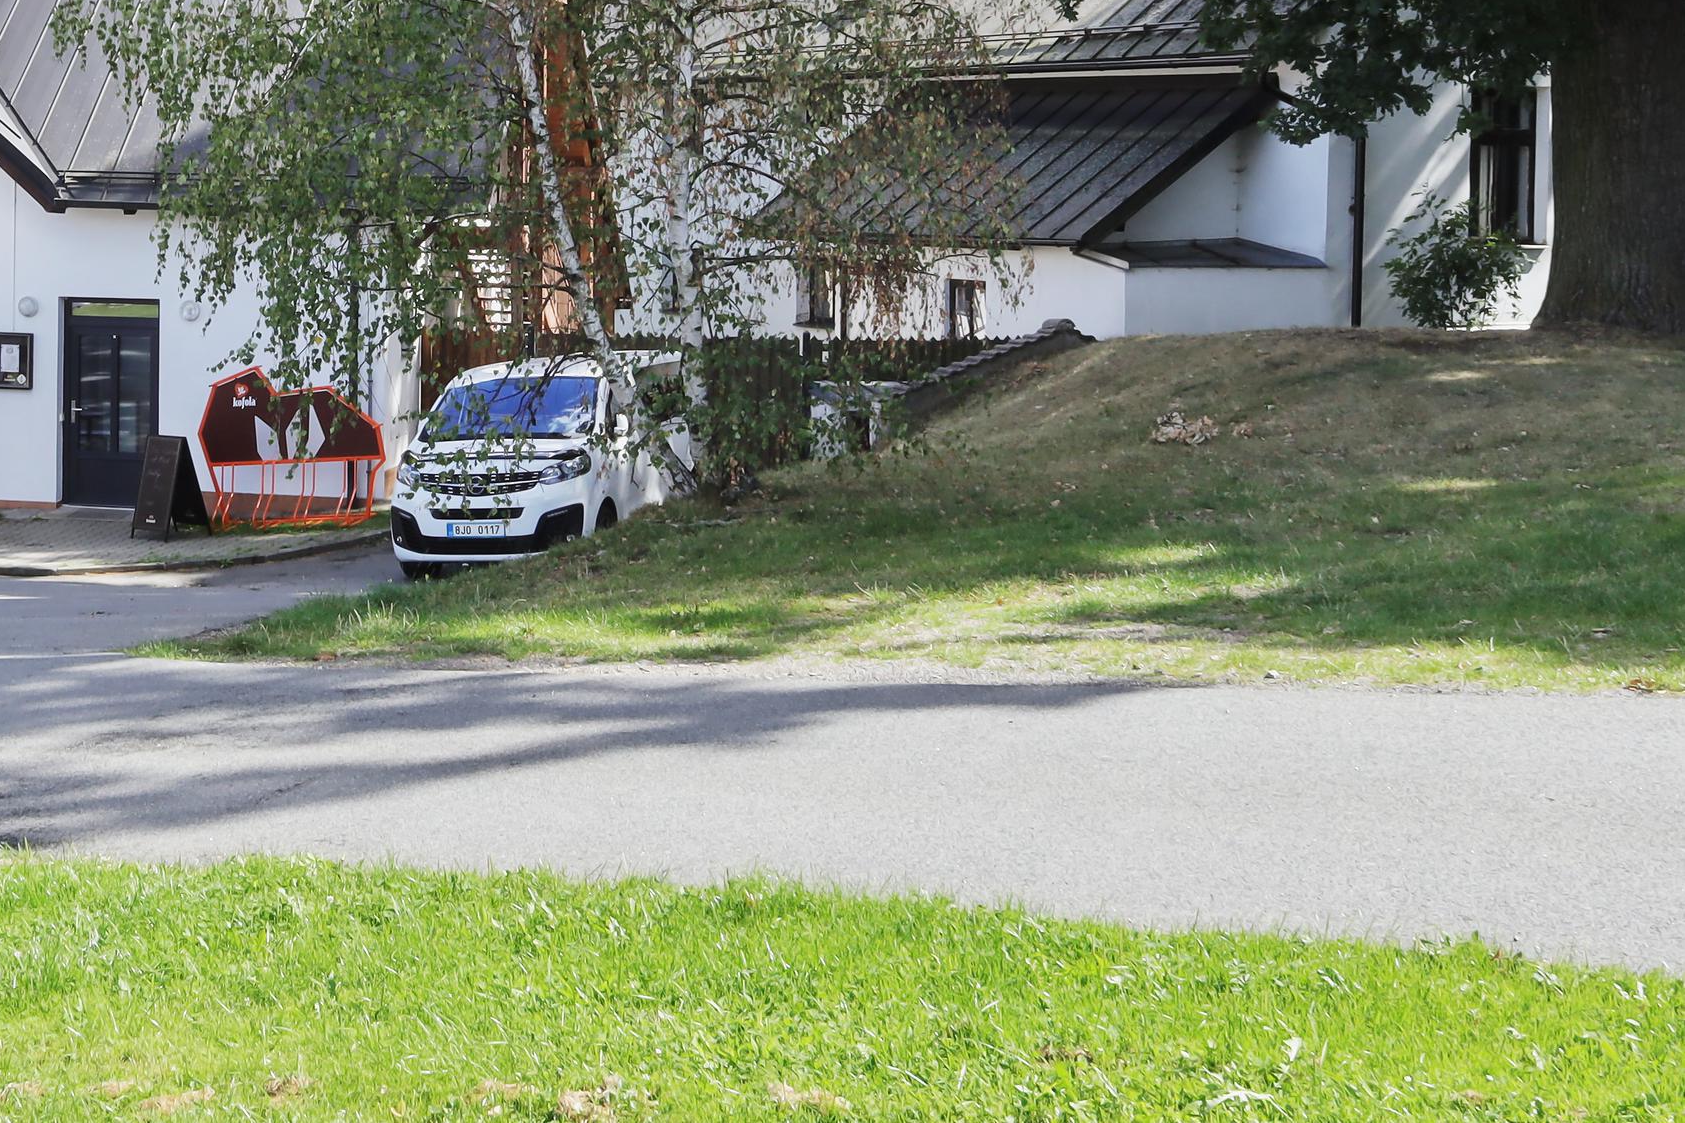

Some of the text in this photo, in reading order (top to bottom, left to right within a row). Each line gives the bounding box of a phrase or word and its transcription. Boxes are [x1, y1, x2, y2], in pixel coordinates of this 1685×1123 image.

[232, 396, 257, 410] kofola
[455, 525, 500, 535] 8J0 0117
